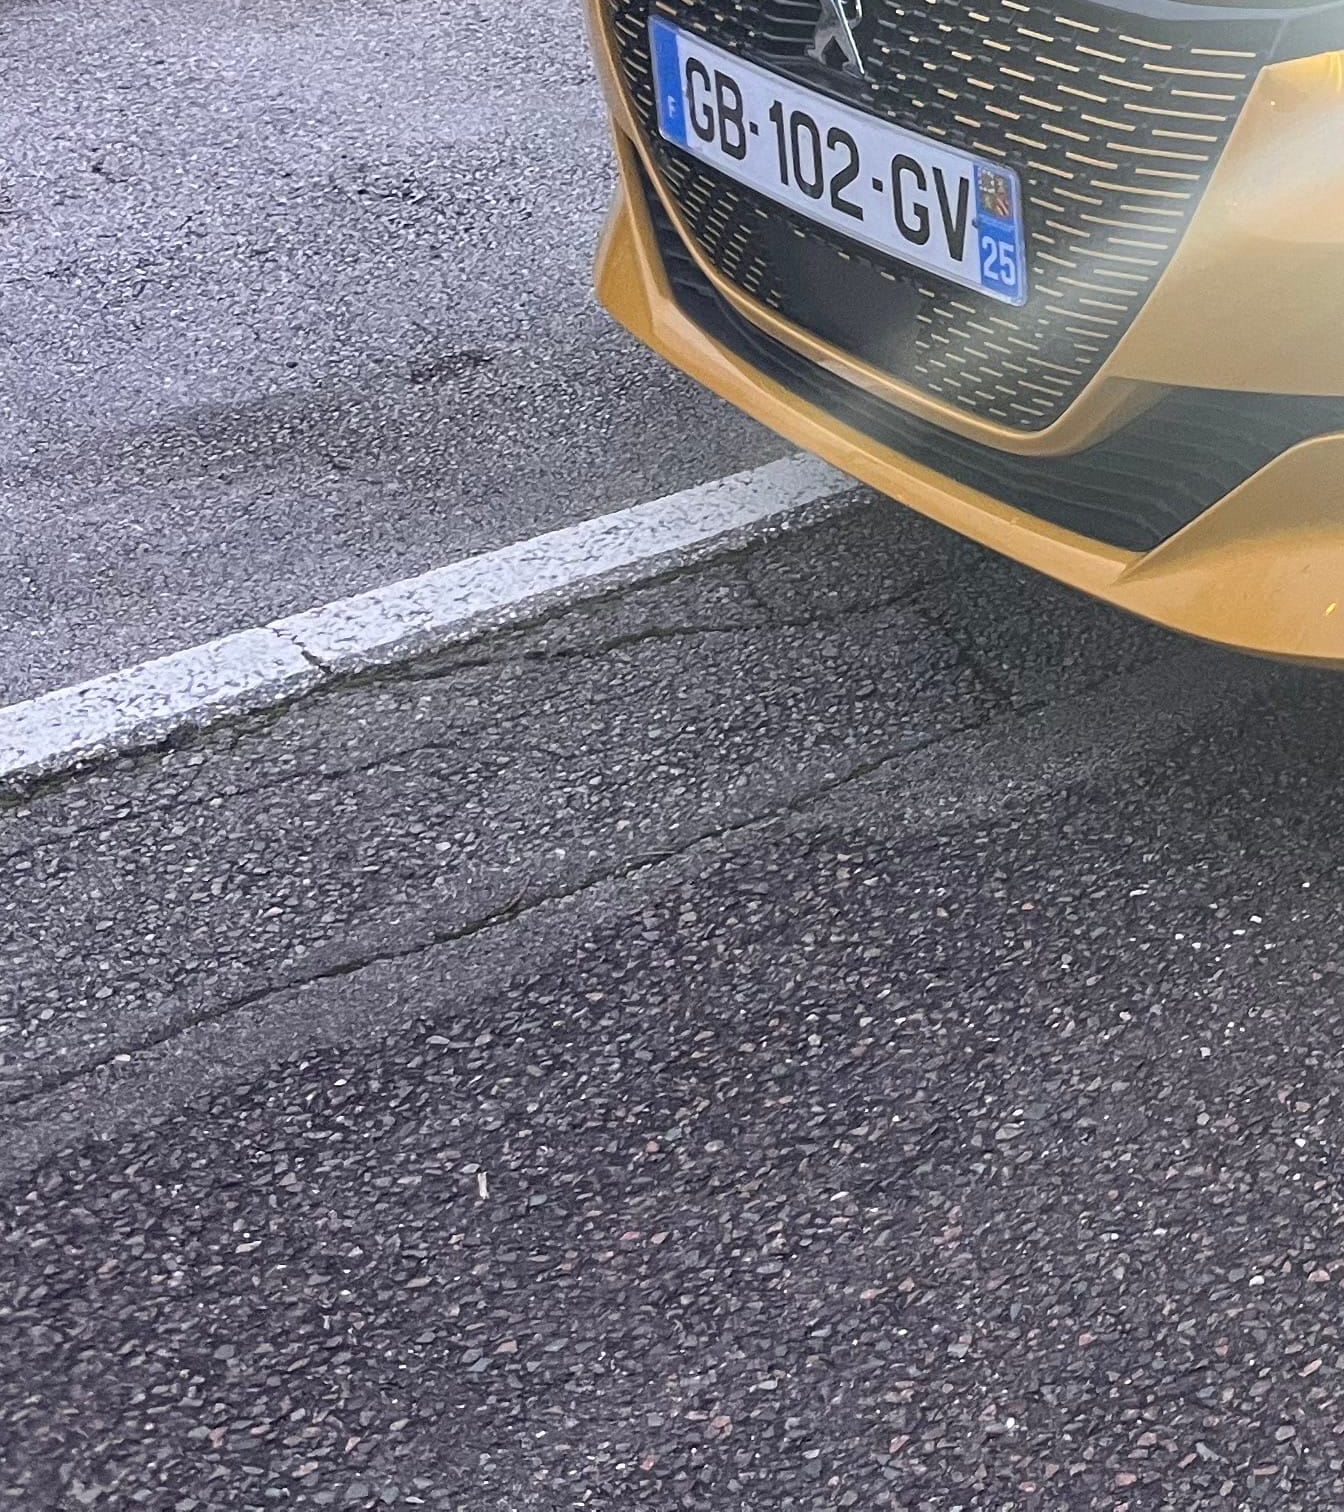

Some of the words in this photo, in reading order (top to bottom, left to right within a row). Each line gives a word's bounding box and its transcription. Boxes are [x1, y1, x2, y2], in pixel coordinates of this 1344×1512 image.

[667, 95, 677, 119] F
[686, 57, 969, 262] GB-102-GV
[982, 235, 1017, 286] 25
